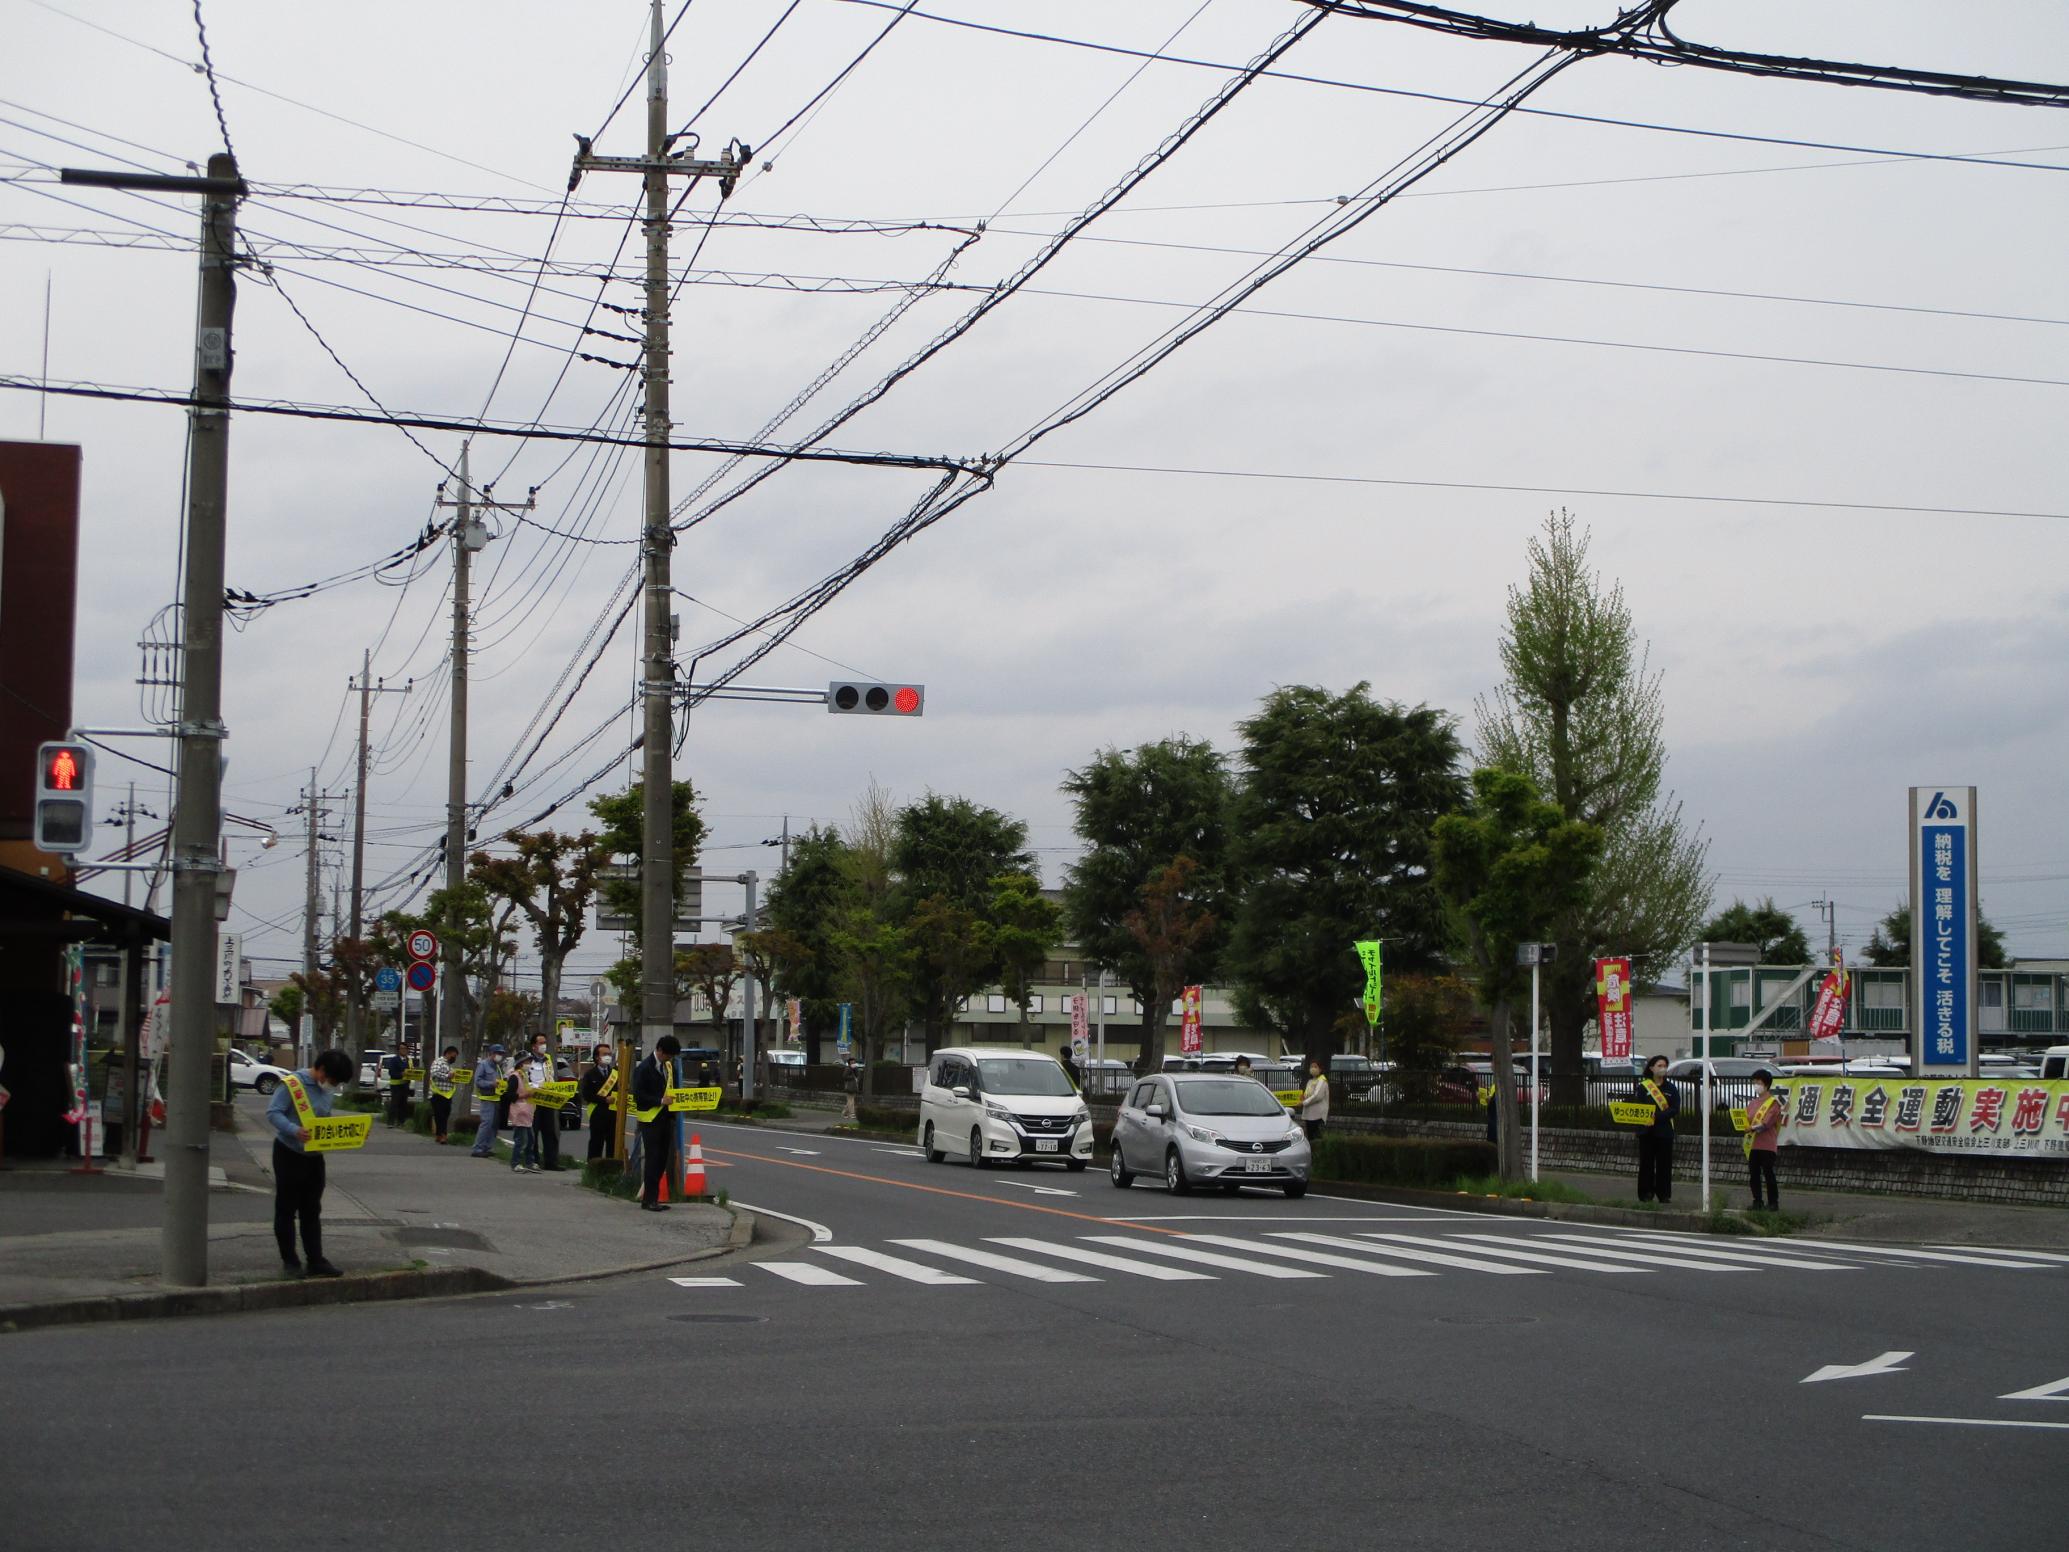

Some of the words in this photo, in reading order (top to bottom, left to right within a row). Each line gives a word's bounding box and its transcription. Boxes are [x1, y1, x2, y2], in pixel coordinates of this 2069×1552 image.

[1934, 832, 1952, 881] 納税を
[414, 938, 430, 951] 50
[1935, 887, 1953, 984] 理解してこそ
[381, 974, 395, 984] 35
[1936, 989, 1954, 1055] 活きる税
